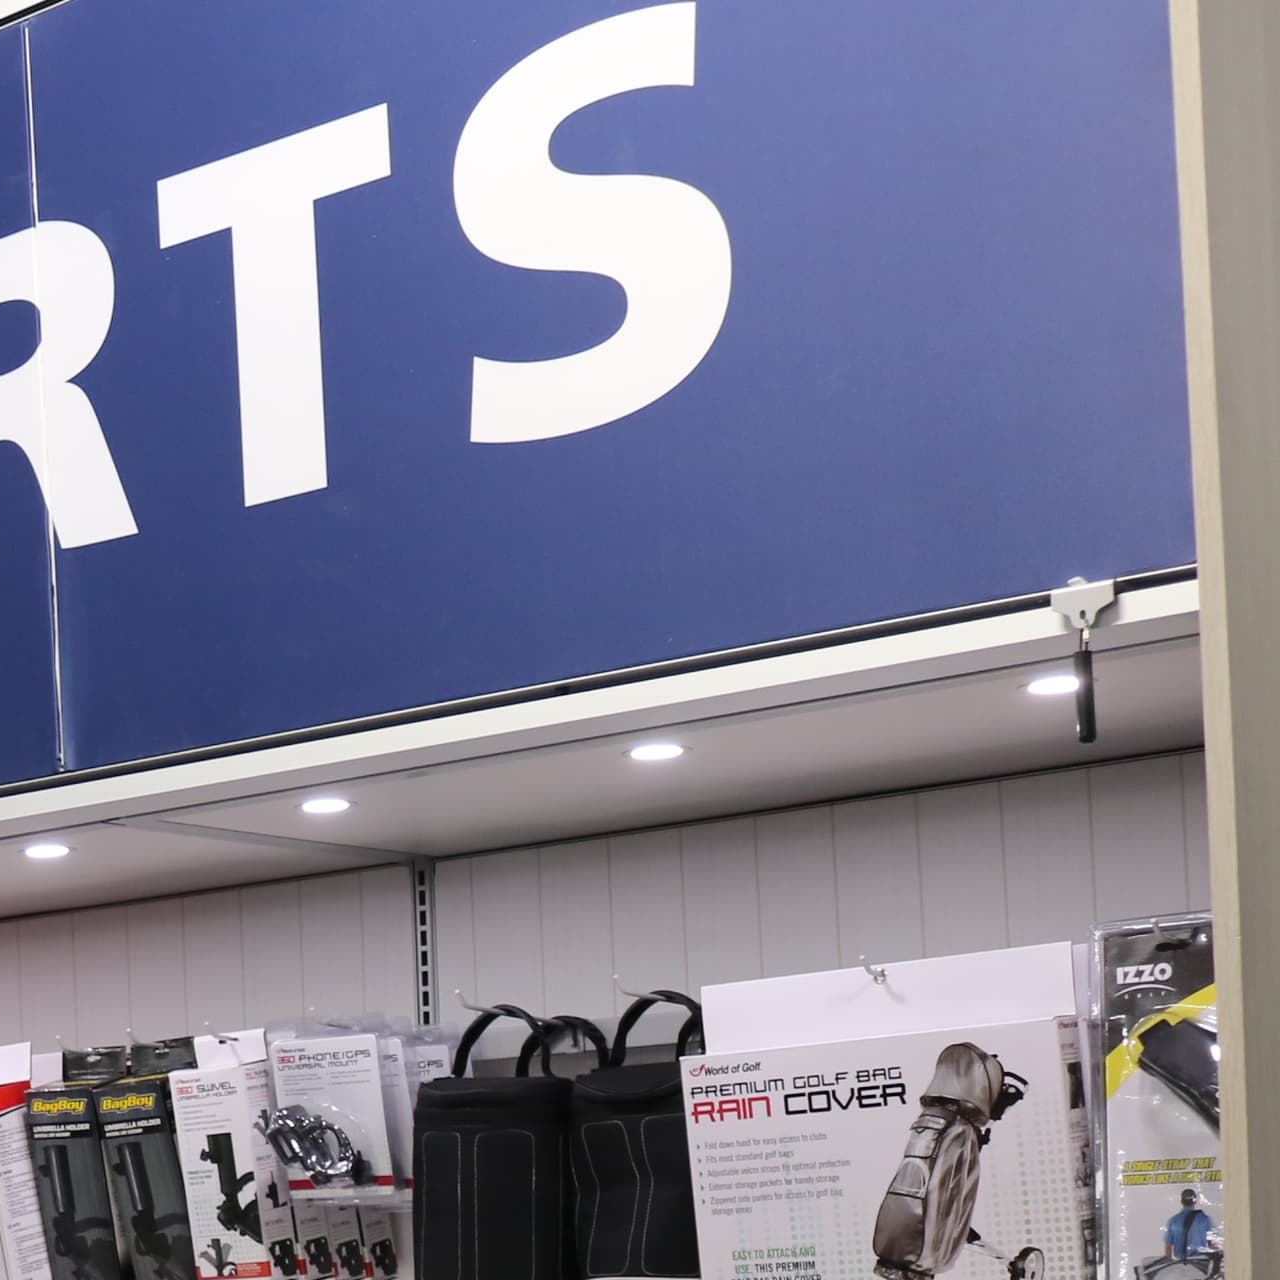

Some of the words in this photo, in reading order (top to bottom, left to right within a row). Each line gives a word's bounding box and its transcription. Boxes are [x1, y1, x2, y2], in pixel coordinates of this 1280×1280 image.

[1116, 962, 1173, 985] IZZO
[298, 1050, 371, 1062] PHONE/GPS
[277, 1061, 325, 1072] UNIVERSAL
[326, 1058, 359, 1068] MOUNT
[704, 1065, 729, 1077] World
[731, 1064, 740, 1074] of
[742, 1062, 762, 1073] Golf
[197, 1082, 237, 1092] SWIVEL
[690, 1078, 784, 1099] PREMIUM
[793, 1072, 848, 1090] GOLF
[856, 1066, 902, 1083] BAG
[32, 1098, 86, 1115] BagBoy
[101, 1094, 155, 1112] BagBoy
[691, 1096, 772, 1124] RAIN
[784, 1083, 907, 1115] COVER
[755, 1263, 774, 1273] THIS
[776, 1261, 816, 1273] PREMIUM
